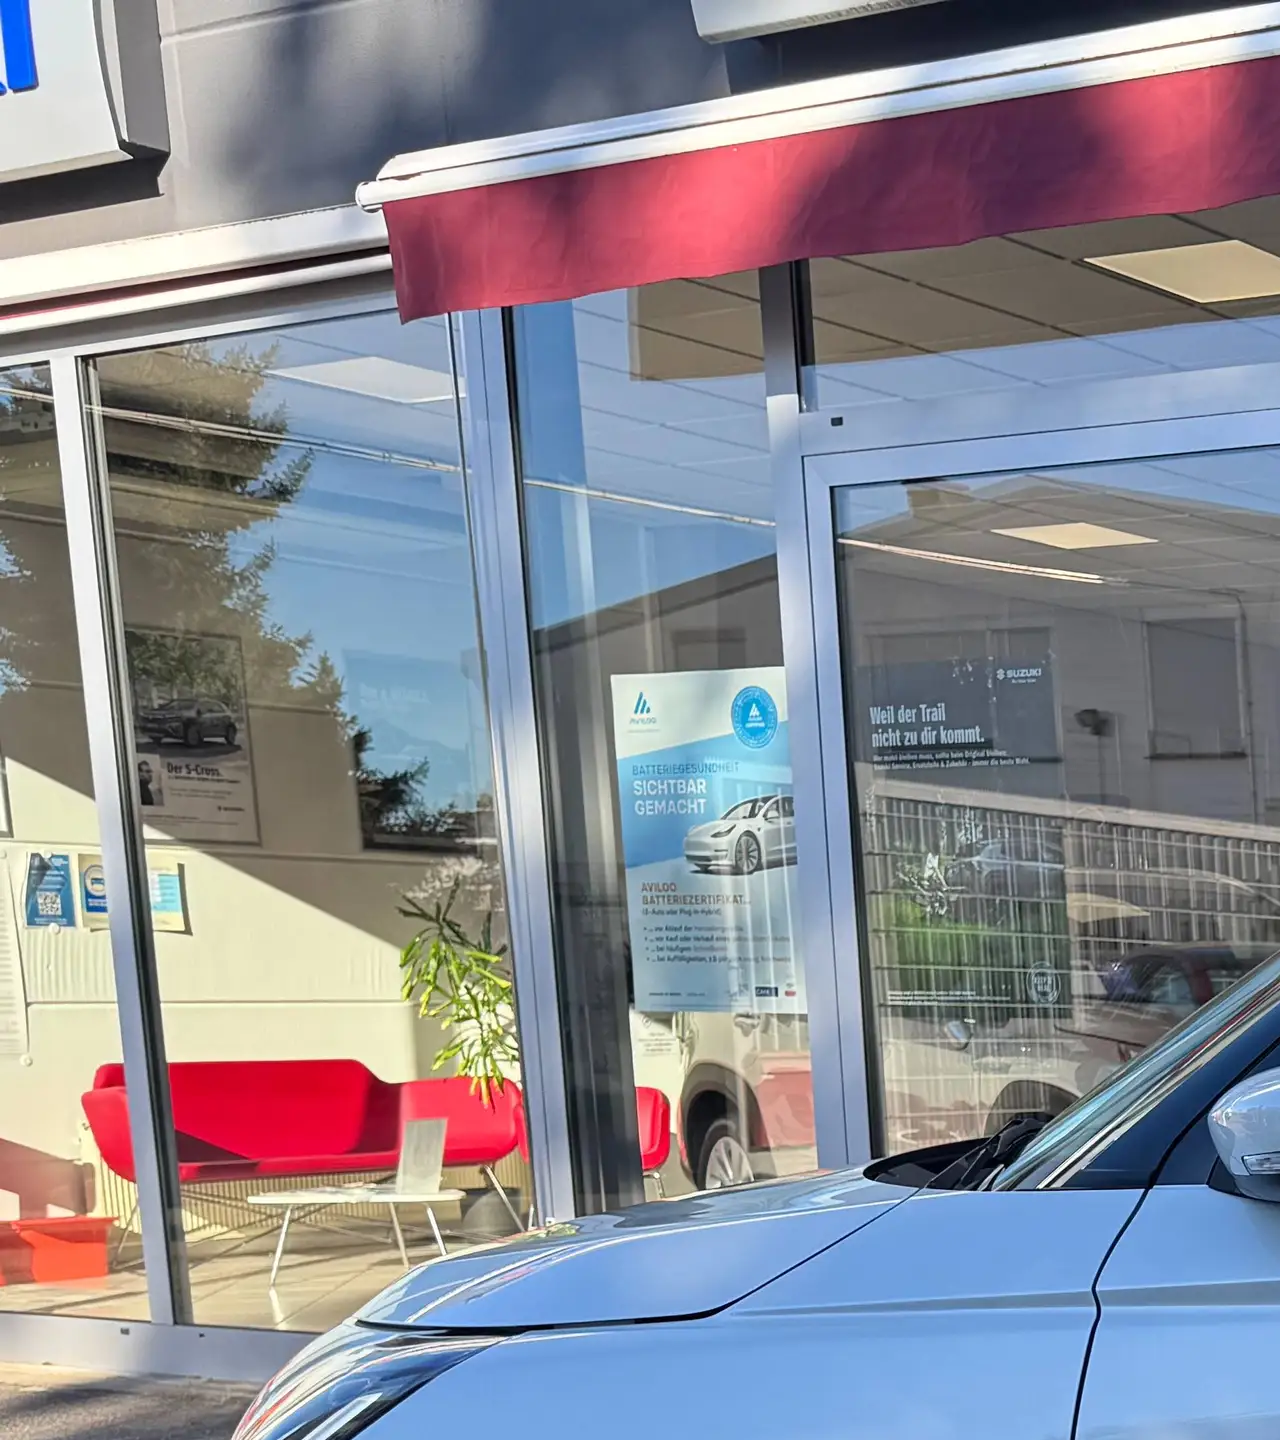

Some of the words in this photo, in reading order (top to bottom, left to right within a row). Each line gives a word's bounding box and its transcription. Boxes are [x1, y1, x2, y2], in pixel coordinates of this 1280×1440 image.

[1006, 668, 1042, 678] SUZUKI
[869, 705, 895, 724] Weil
[897, 705, 917, 723] der
[919, 703, 946, 722] Trail
[871, 728, 901, 747] nicht
[904, 731, 917, 746] zu
[921, 727, 937, 745] dir
[940, 725, 985, 744] kommt.
[166, 762, 182, 774] Der
[632, 762, 739, 776] BATTERIEGESUNDHEIT
[633, 778, 707, 796] SICHTBAR
[634, 799, 707, 816] GEMACHT
[641, 882, 677, 893] AVILOO
